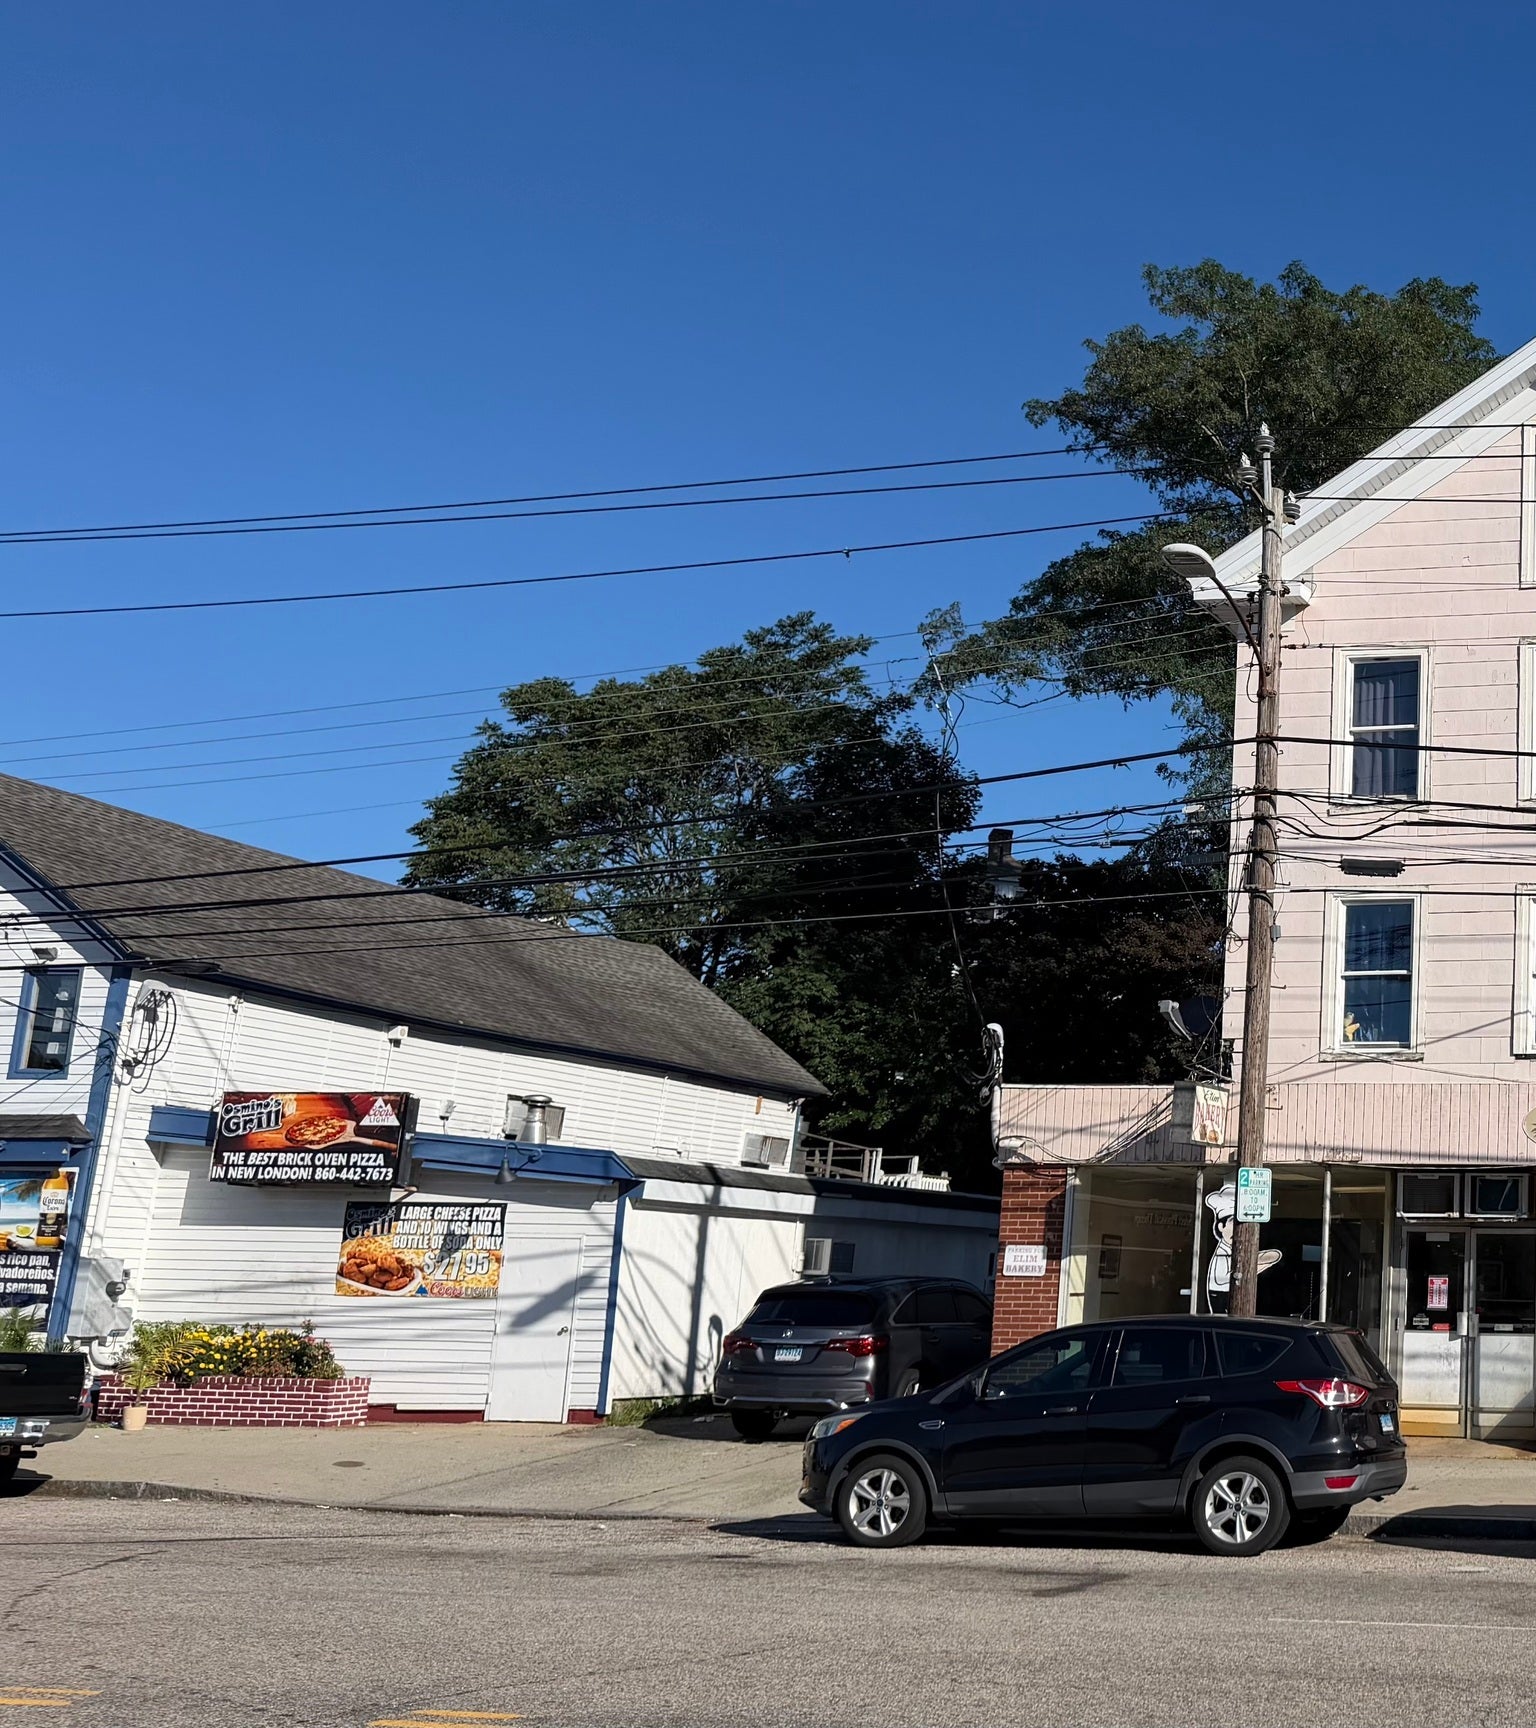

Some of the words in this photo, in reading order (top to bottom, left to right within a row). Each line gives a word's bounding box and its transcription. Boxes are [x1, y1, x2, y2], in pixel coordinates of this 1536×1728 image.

[221, 1109, 283, 1137] Grill
[223, 1152, 246, 1165] THE
[249, 1152, 279, 1165] BEST
[278, 1153, 313, 1166] BRICK
[315, 1153, 348, 1166] OVEN
[350, 1154, 385, 1167] PIZZA
[211, 1166, 225, 1179] IN
[228, 1167, 256, 1180] NEW
[258, 1167, 313, 1180] LONDON!
[315, 1167, 393, 1181] 860-442-7673
[1240, 1171, 1248, 1185] 2
[400, 1206, 432, 1220] LARGE
[434, 1206, 471, 1220] CHEESE
[472, 1207, 501, 1220] PIZZA
[397, 1220, 420, 1234] AND
[421, 1221, 434, 1234] 10
[470, 1221, 491, 1235] AND
[493, 1222, 502, 1235] A
[393, 1236, 430, 1249] BOTTLE
[433, 1236, 445, 1249] OF
[446, 1236, 474, 1249] SODA
[476, 1236, 502, 1250] ONLY
[7, 1252, 27, 1265] rico
[29, 1255, 50, 1267] pan,
[0, 1266, 55, 1280] vadoreños.
[1005, 1265, 1043, 1273] BAKERY
[5, 1282, 48, 1294] semana.
